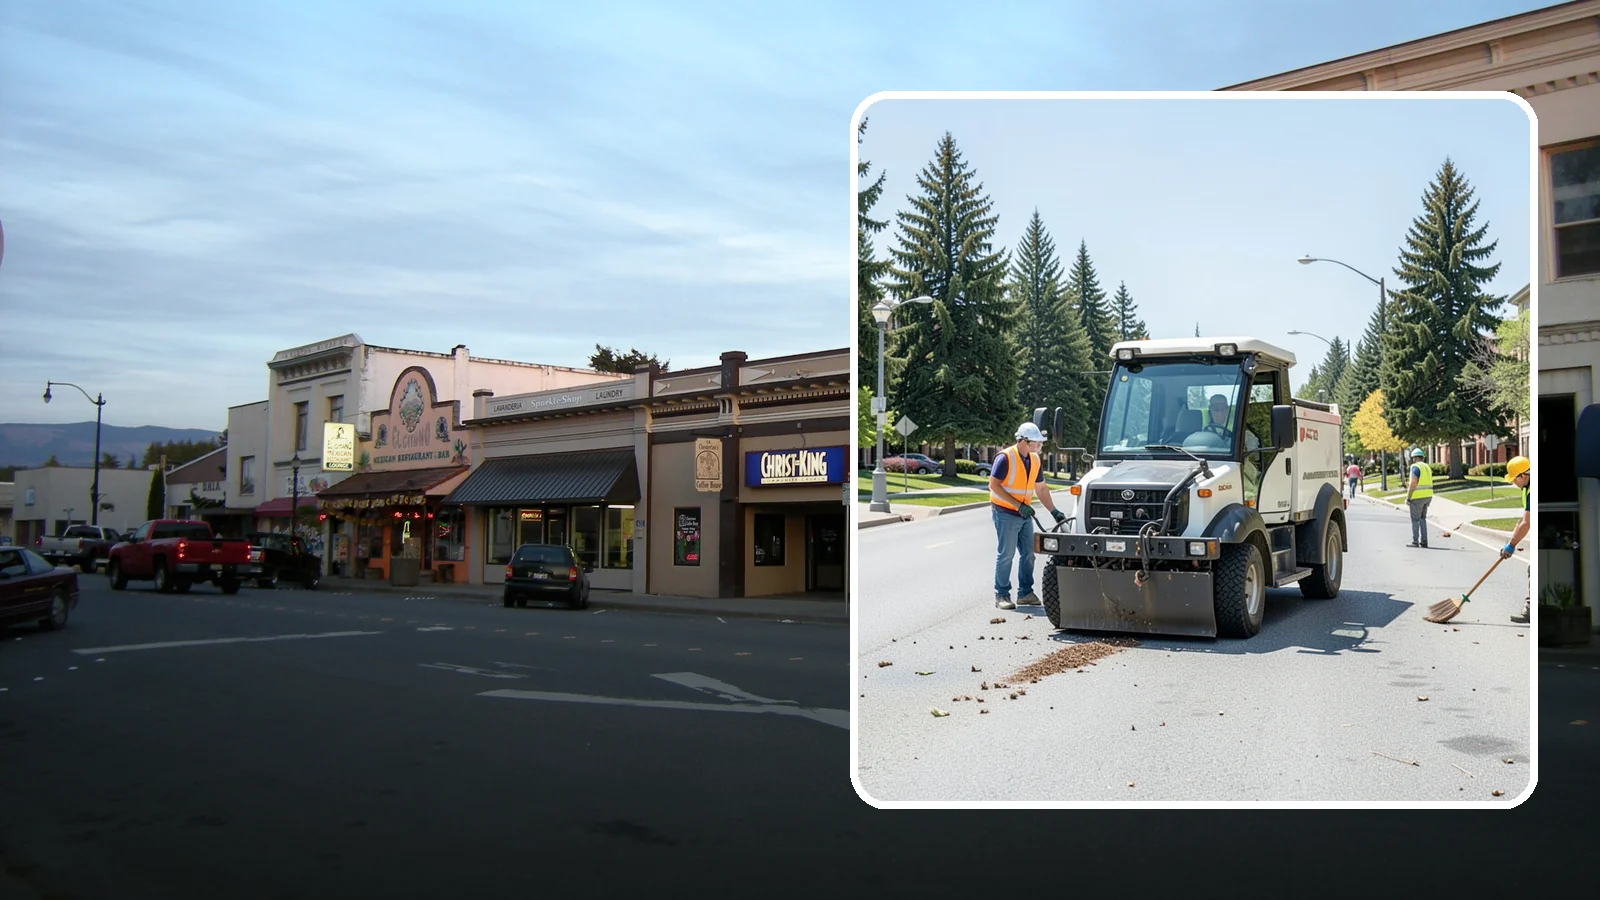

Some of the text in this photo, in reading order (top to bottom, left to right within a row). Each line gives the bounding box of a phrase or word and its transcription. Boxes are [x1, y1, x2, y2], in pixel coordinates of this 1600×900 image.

[595, 389, 624, 400] LAUNDRY
[494, 402, 523, 412] LAVANDERIA
[530, 394, 583, 409] Sparkle Shop
[397, 451, 434, 462] RESTAURANT
[437, 450, 450, 459] BAR
